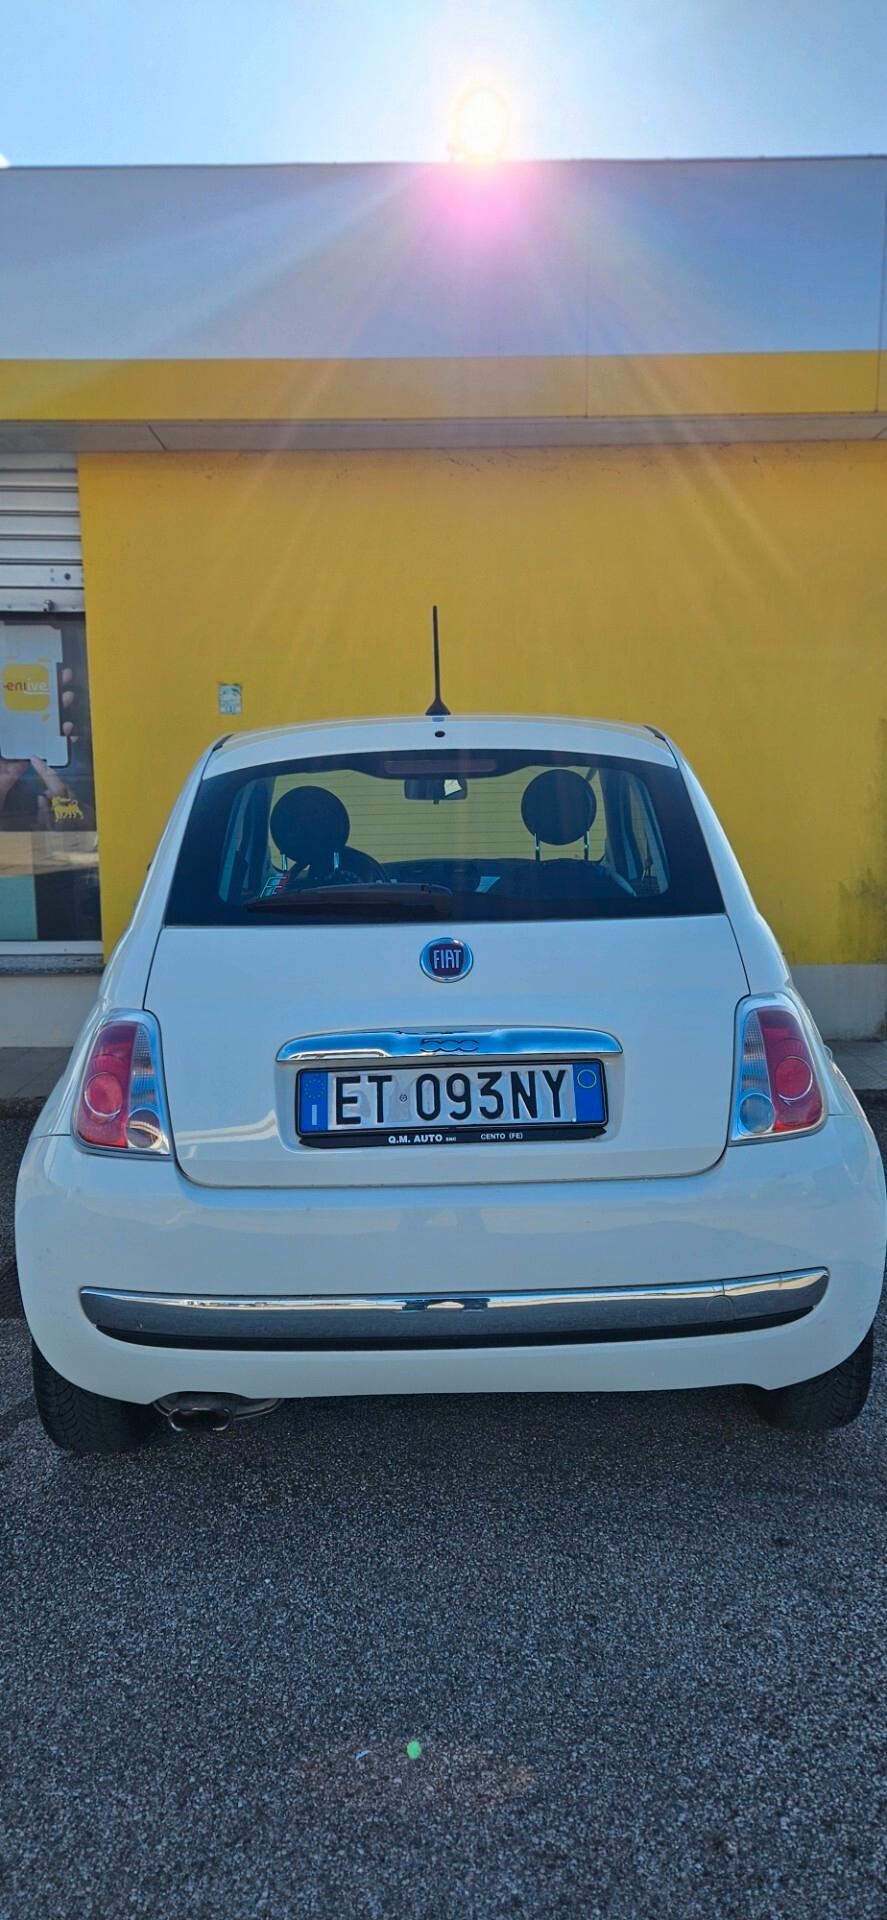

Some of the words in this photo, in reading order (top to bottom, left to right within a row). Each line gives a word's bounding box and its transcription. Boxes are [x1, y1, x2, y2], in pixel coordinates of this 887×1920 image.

[433, 949, 462, 969] FIAT
[420, 1038, 480, 1052] 500
[335, 1075, 393, 1125] ET
[416, 1069, 567, 1121] 093NY
[388, 1135, 411, 1144] Q.M.
[413, 1134, 443, 1143] AUTO
[508, 1132, 523, 1140] (FE)
